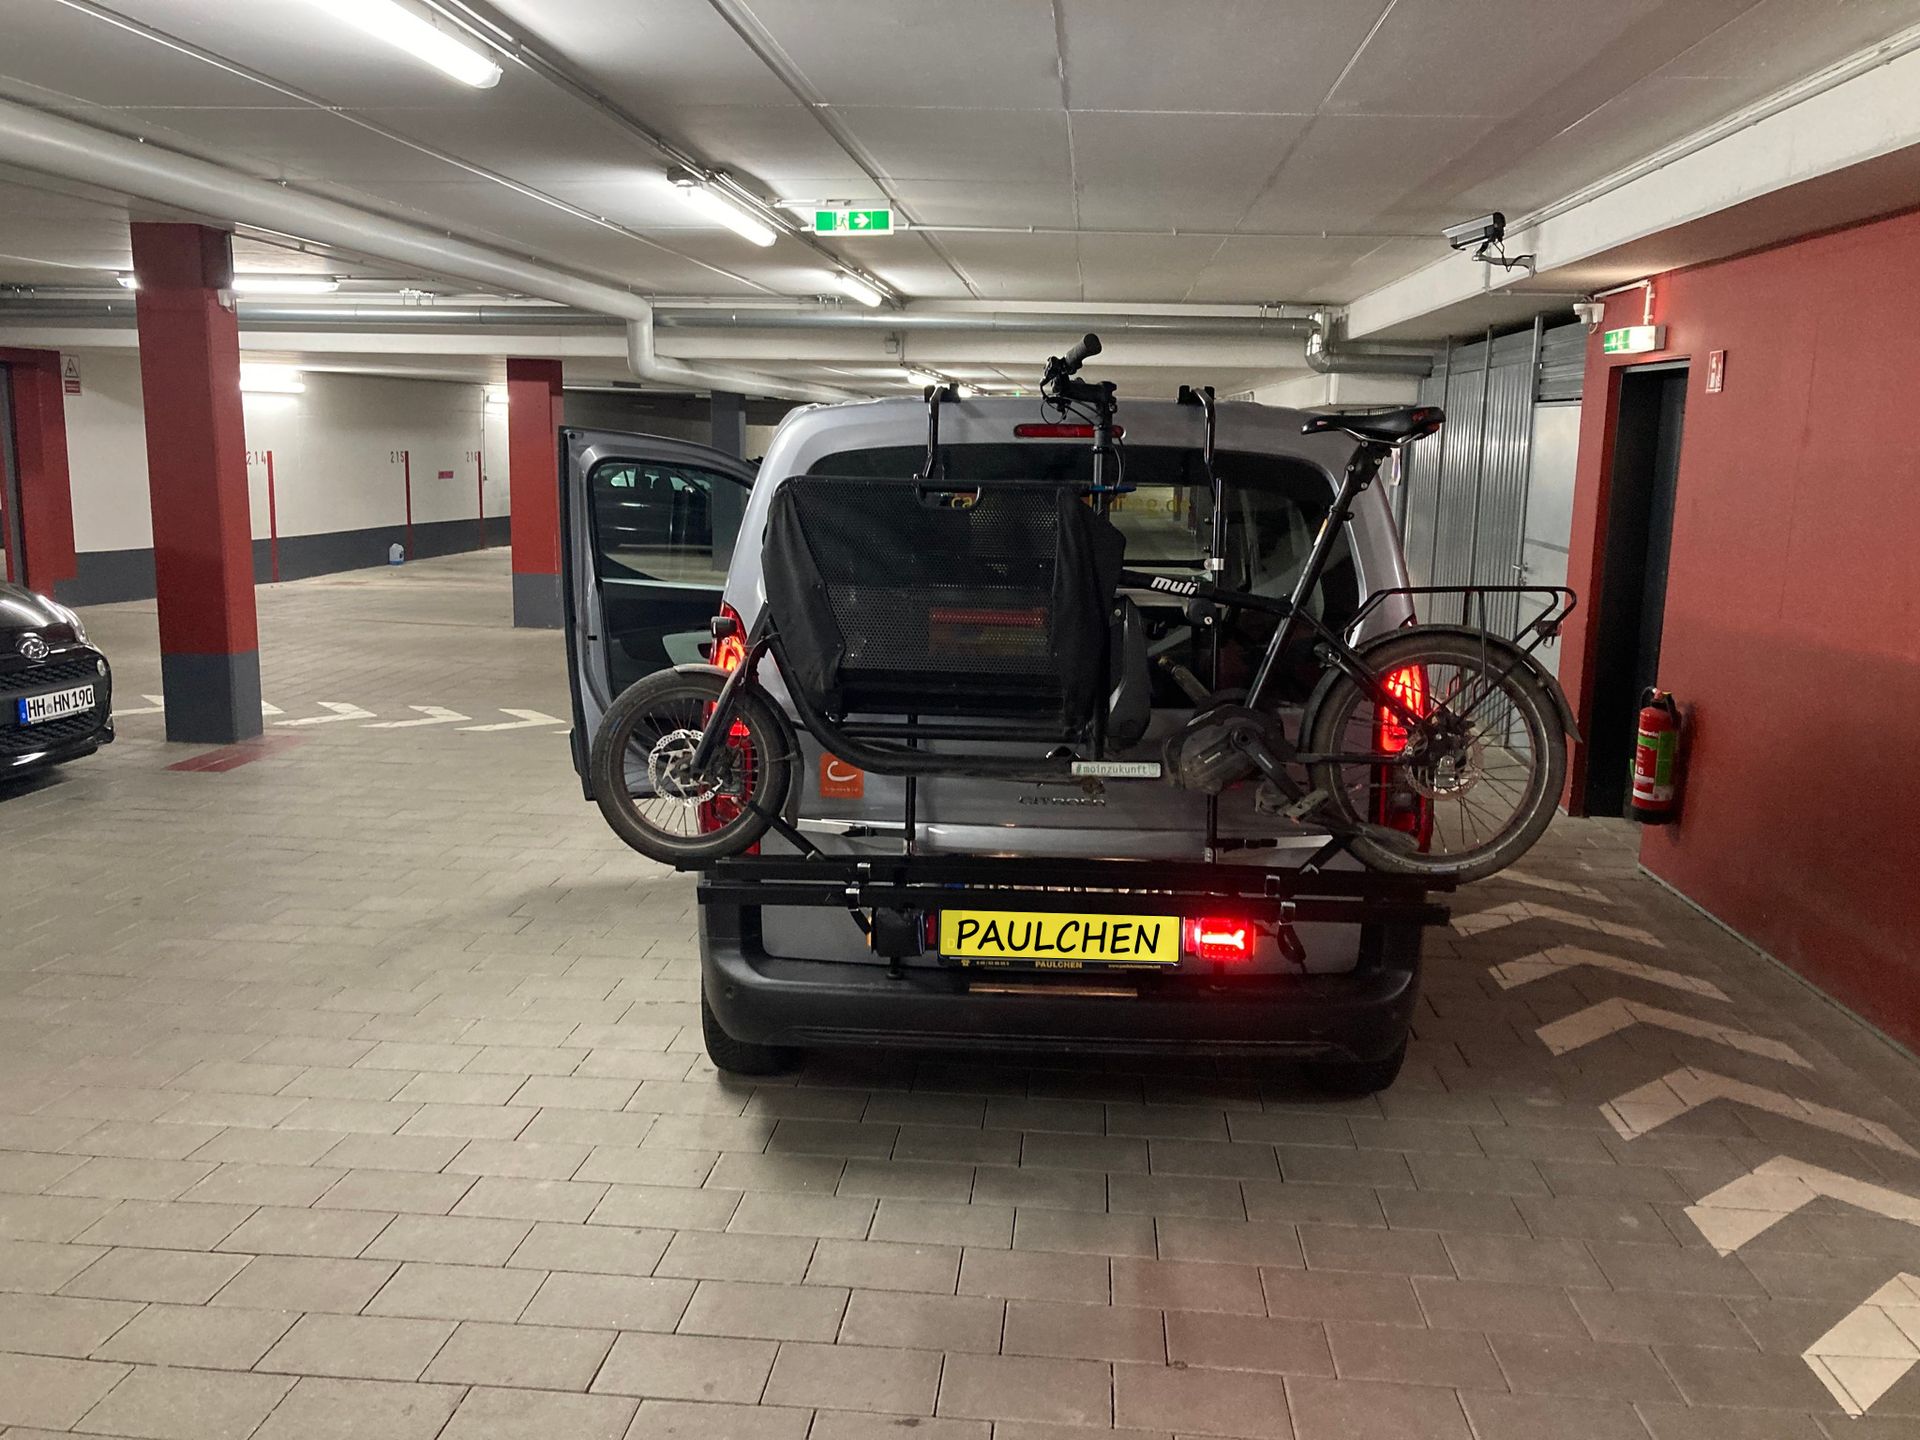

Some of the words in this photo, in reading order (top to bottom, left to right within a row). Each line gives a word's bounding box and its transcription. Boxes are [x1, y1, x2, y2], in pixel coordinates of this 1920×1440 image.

[246, 450, 266, 465] 214
[390, 451, 405, 463] 215
[1151, 577, 1197, 595] muli
[27, 697, 46, 718] HH
[53, 693, 71, 713] HN
[71, 688, 93, 708] 190
[1076, 765, 1147, 776] #moinzukunft
[957, 919, 1161, 954] PAULCHEN
[1035, 961, 1082, 969] PAULCHEN
